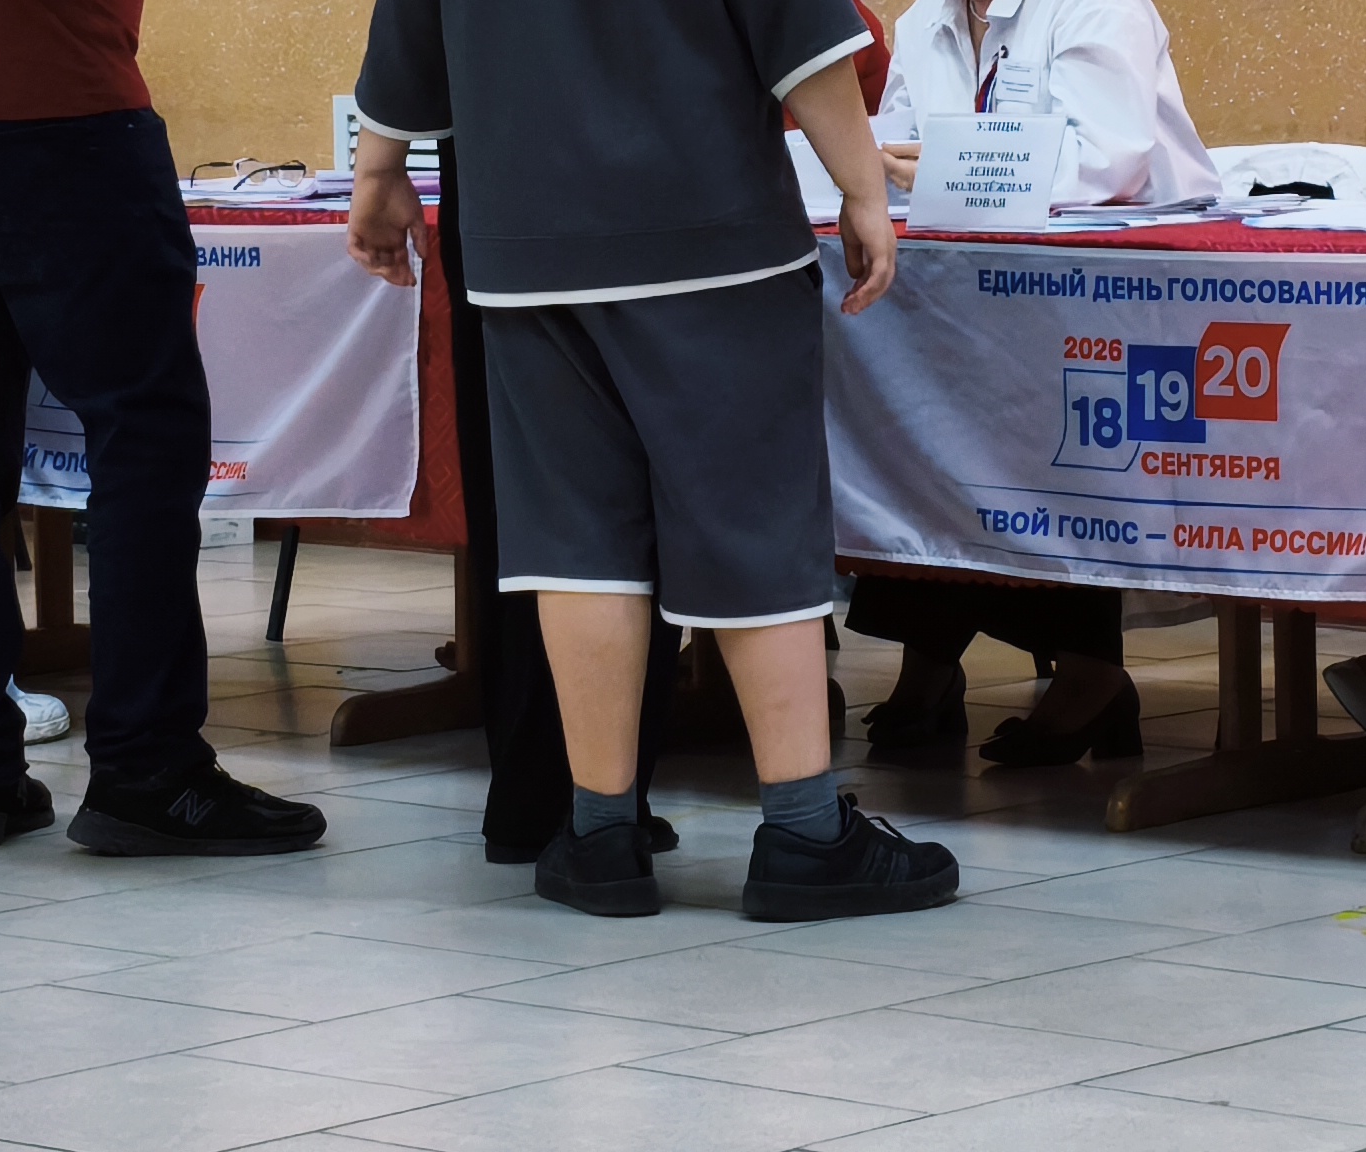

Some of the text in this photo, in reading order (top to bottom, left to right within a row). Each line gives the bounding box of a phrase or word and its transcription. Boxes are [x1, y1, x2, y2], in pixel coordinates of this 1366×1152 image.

[958, 151, 1031, 162] КУЗНЕЧНАЯ
[965, 166, 1015, 177] ЛЕНИНА
[945, 180, 1032, 193] МОЛОДЁЖНАЯ
[965, 197, 1006, 208] НОВАЯ
[196, 246, 260, 267] ВАНИЯ
[978, 268, 1086, 297] ЕДИНЫЙ
[1092, 275, 1162, 303] ДЕНЬ
[1064, 336, 1122, 361] 2026
[1072, 345, 1270, 449] 18 19 20
[41, 450, 88, 473] ГОЛО
[1141, 451, 1280, 480] СЕНТЯБРЯ
[976, 506, 1049, 536] ТВОЙ
[1058, 514, 1138, 545] ГОЛОС
[1174, 524, 1244, 551] СИЛА
